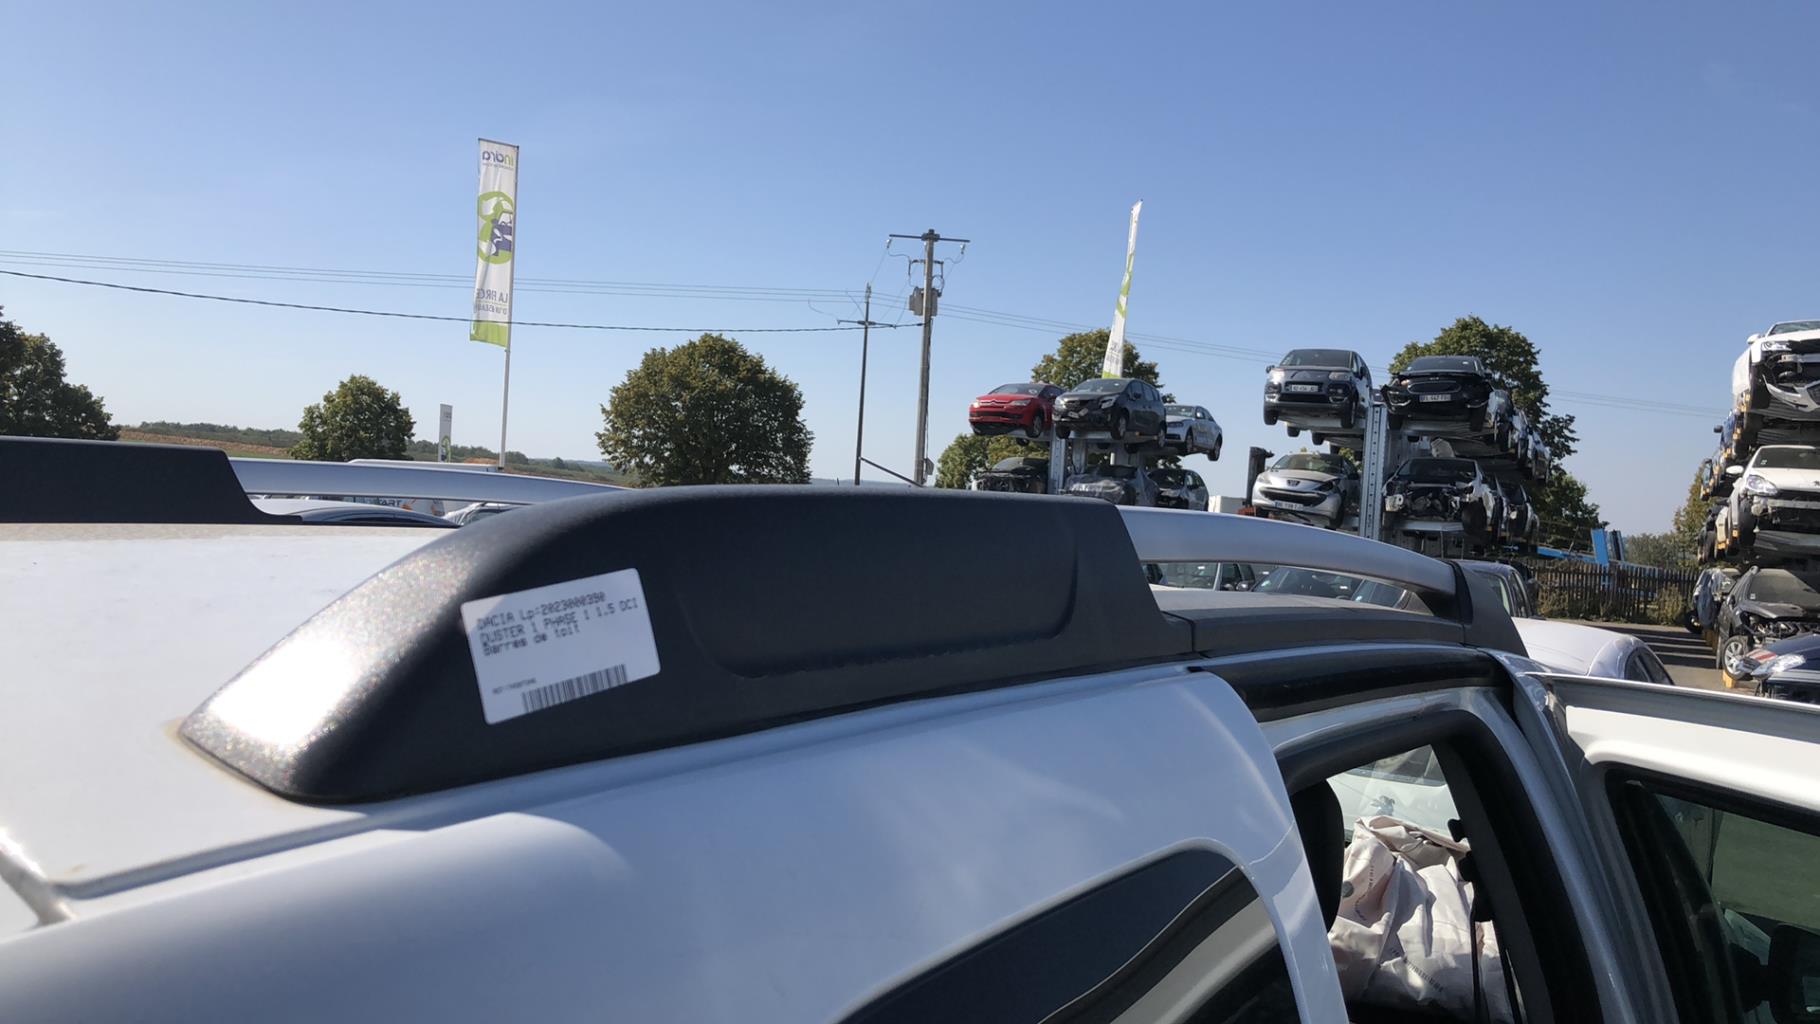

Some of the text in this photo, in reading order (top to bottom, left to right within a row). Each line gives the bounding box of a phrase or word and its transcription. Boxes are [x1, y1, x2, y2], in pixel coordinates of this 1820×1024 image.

[477, 611, 515, 631] DACIA
[480, 624, 525, 644] DUSTER
[543, 611, 577, 629] PHASE
[596, 604, 615, 617] 1.5
[619, 597, 639, 612] DCI
